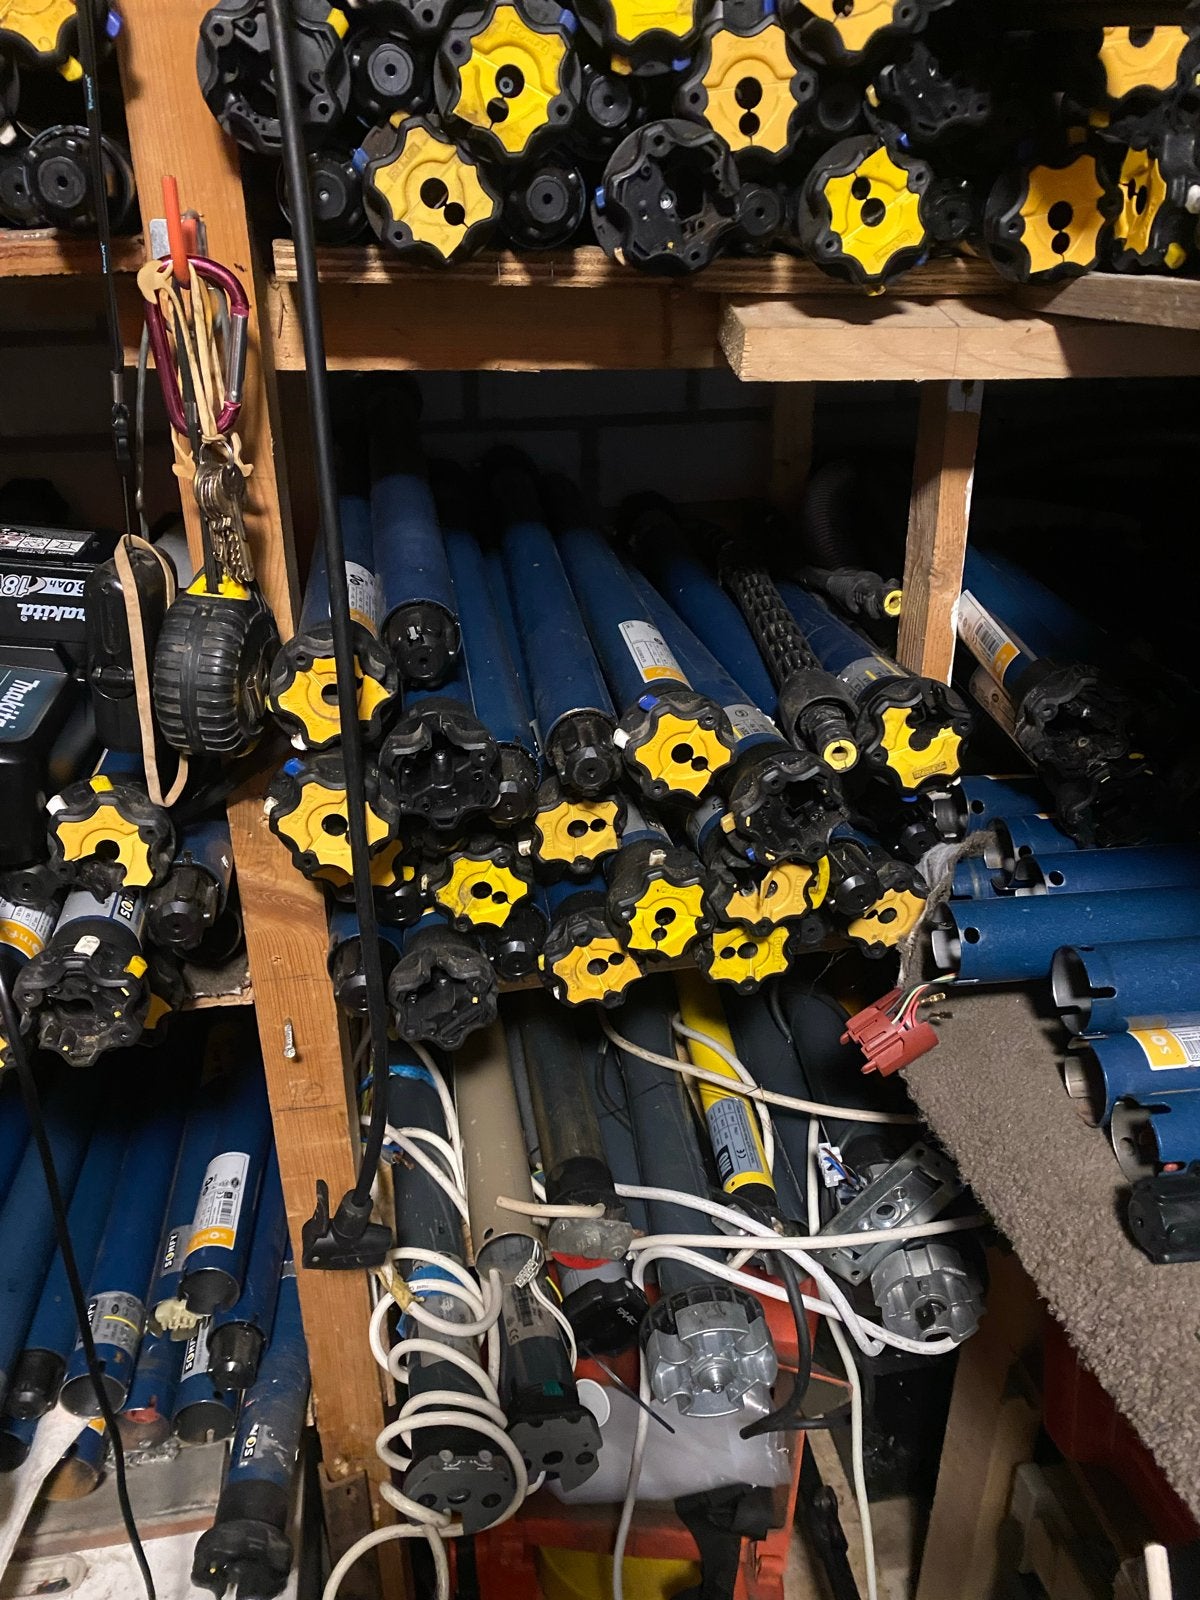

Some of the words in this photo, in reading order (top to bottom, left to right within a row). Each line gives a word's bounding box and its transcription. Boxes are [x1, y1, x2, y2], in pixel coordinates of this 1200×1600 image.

[0, 574, 32, 598] 18
[0, 679, 40, 727] makit
[164, 1234, 178, 1268] SOMFY
[616, 1306, 639, 1325] FAAC
[184, 1337, 198, 1371] SOMF
